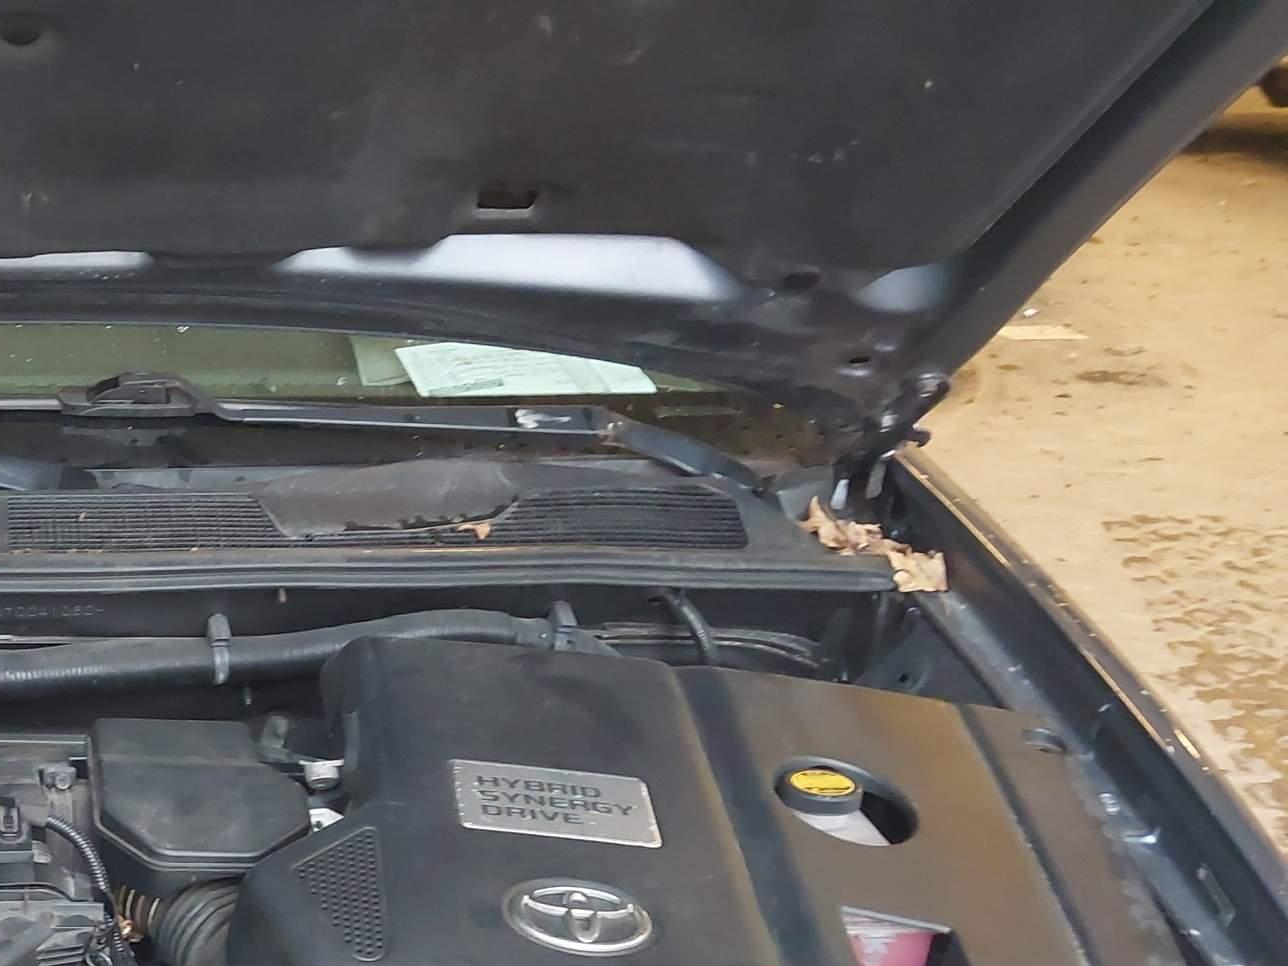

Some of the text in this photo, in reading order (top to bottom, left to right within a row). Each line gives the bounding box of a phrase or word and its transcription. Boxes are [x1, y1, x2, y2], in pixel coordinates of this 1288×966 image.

[476, 775, 602, 799] HYBRID
[477, 789, 634, 816] SYNERGY
[481, 804, 584, 825] DRIVE
